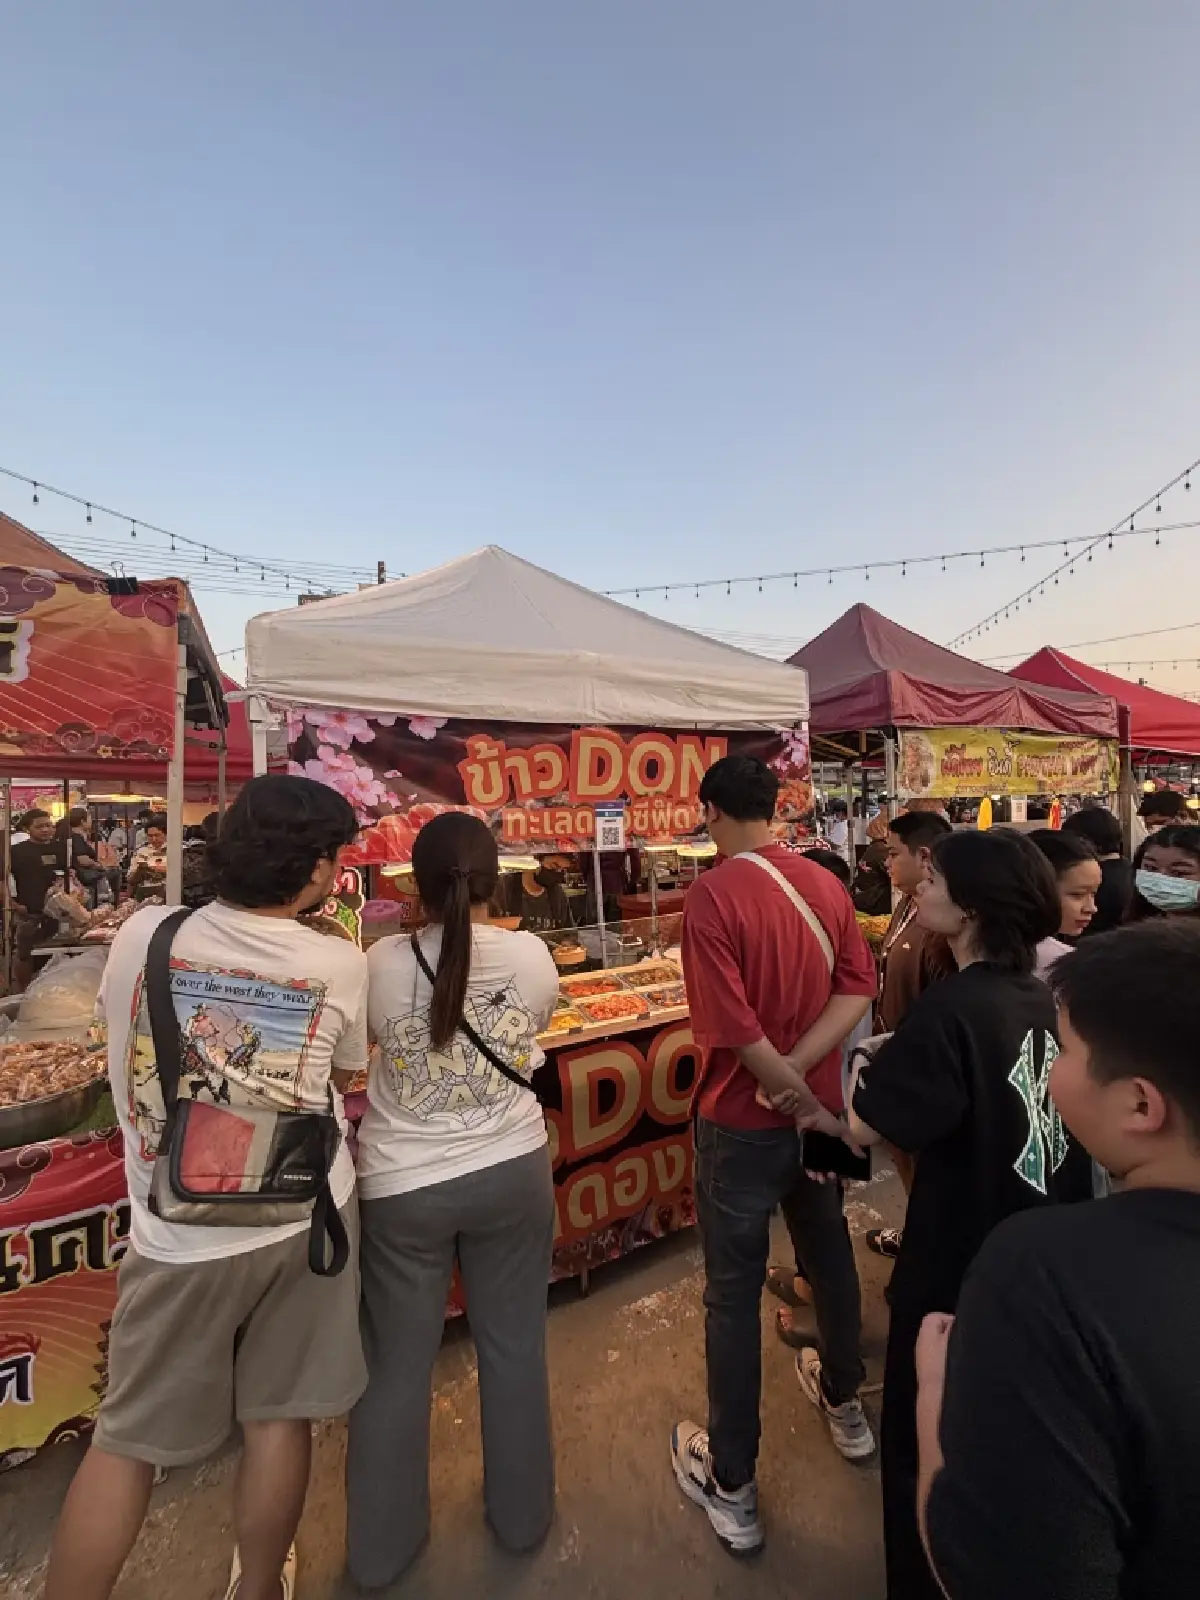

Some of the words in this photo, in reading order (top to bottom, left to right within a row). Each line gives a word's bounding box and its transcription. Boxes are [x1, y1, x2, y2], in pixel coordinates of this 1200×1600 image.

[466, 741, 564, 803] ข้าว
[576, 735, 721, 798] DON
[204, 978, 223, 993] the
[254, 985, 281, 1003] they
[553, 1144, 686, 1238] ดอง
